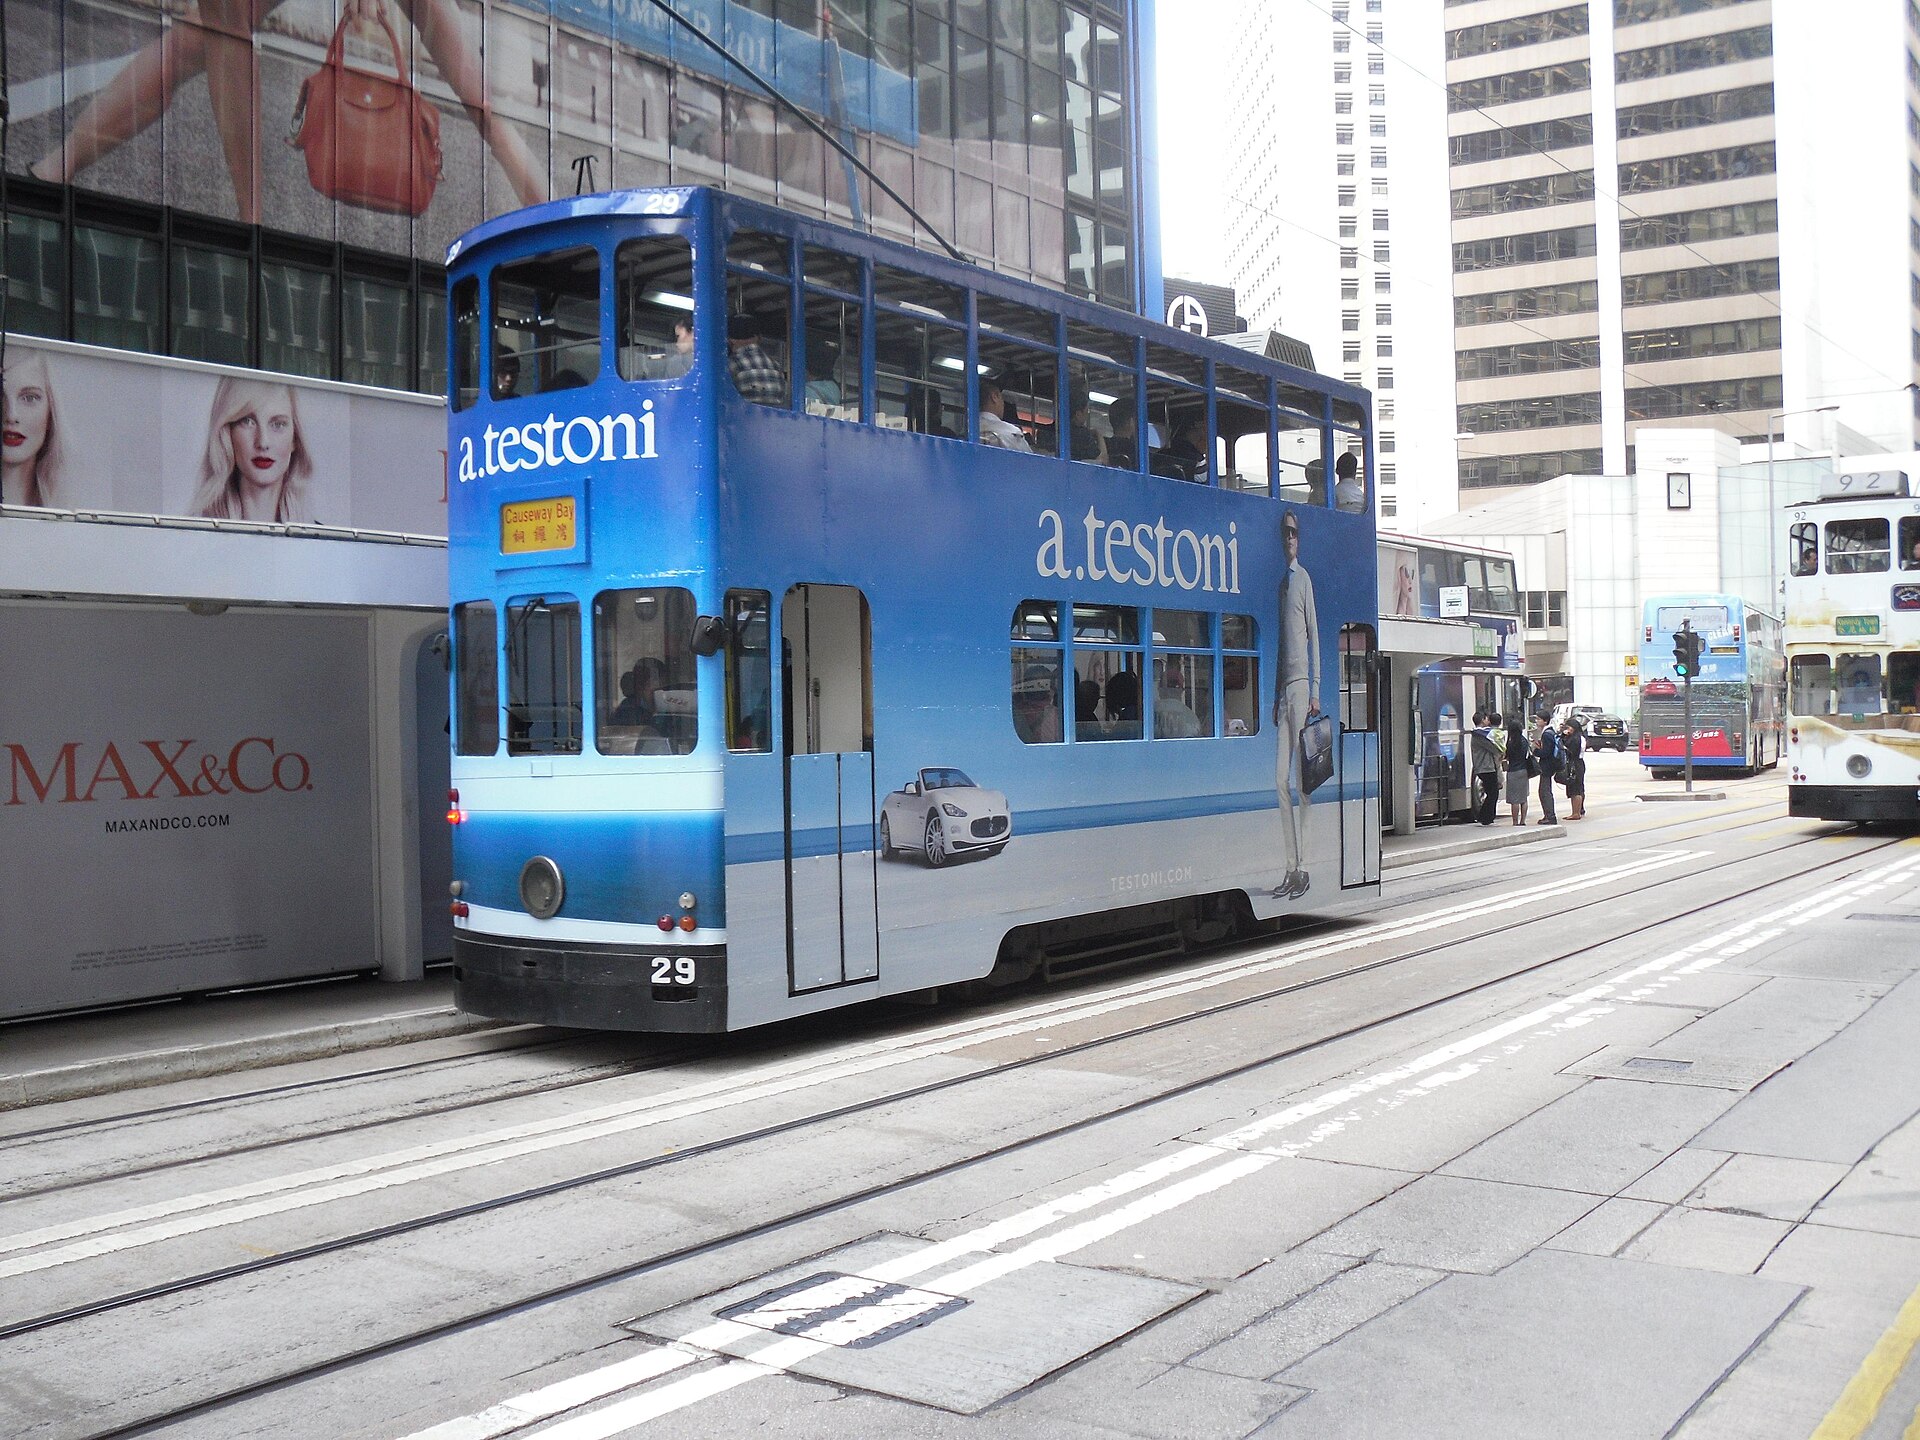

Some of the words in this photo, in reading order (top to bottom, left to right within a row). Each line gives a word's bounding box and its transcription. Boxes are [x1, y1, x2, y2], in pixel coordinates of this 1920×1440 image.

[643, 193, 679, 215] 29
[459, 399, 659, 483] a.testoni
[505, 508, 552, 524] Causeway
[556, 502, 574, 520] Bay
[1794, 511, 1807, 522] 92
[1036, 505, 1241, 594] a.testoni
[4, 737, 314, 805] MAX&Co.
[105, 814, 231, 833] MAXANDCO.COM
[1111, 866, 1192, 891] TESTONI.COM
[651, 957, 696, 985] 29
